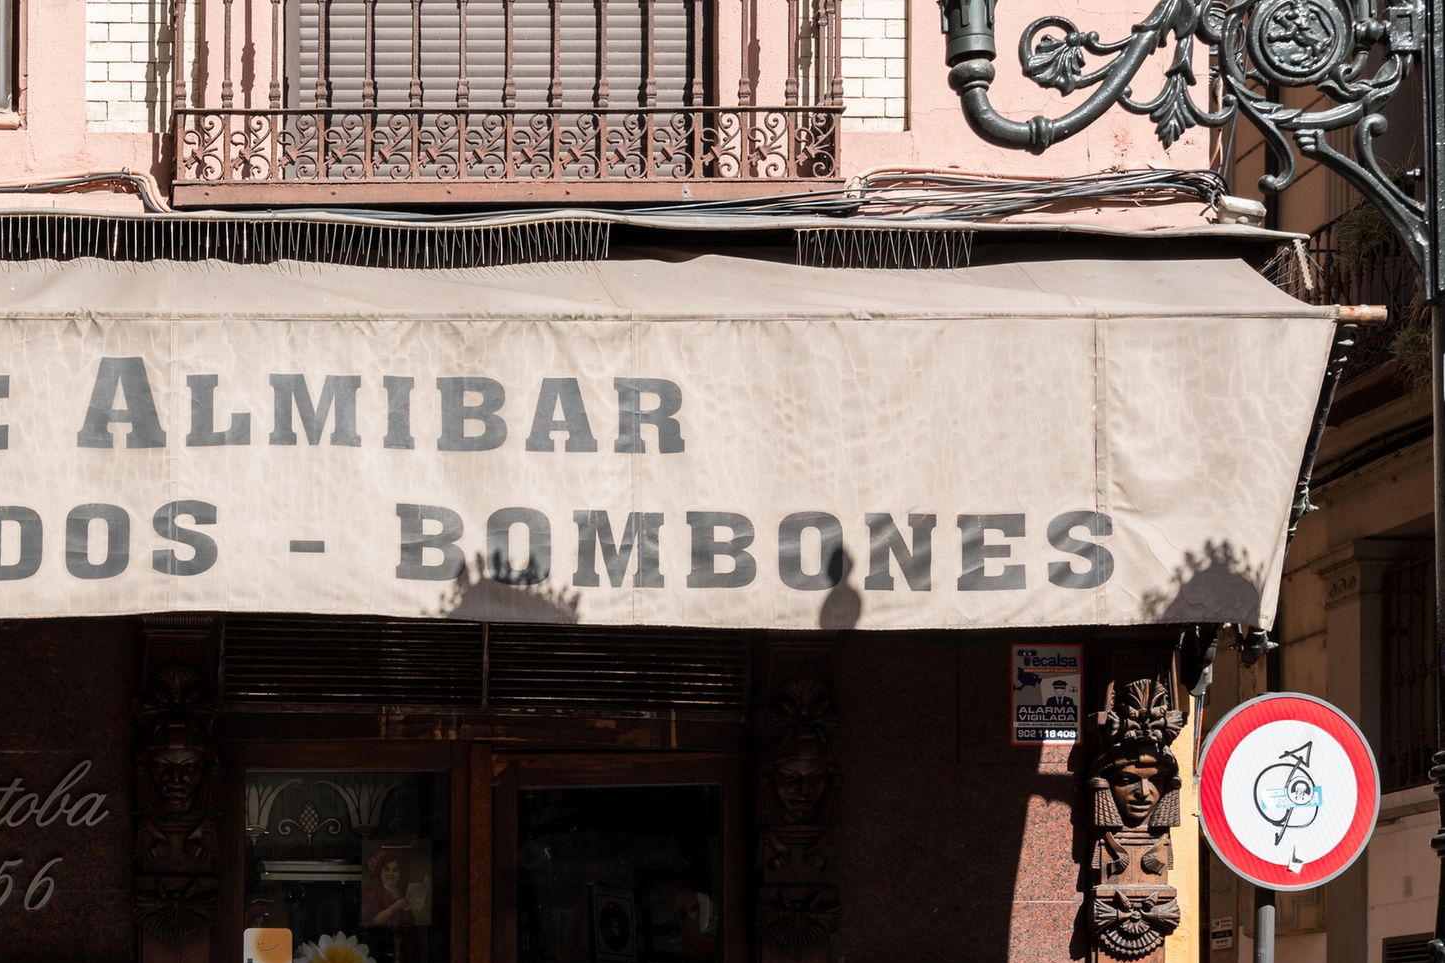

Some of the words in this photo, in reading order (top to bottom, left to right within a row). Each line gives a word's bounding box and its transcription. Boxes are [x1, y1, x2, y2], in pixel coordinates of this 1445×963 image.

[77, 357, 685, 454] ALMIBAR
[395, 502, 1116, 595] BOMBONES
[1017, 649, 1078, 667] Tecalsa
[1018, 706, 1075, 714] ALARMA
